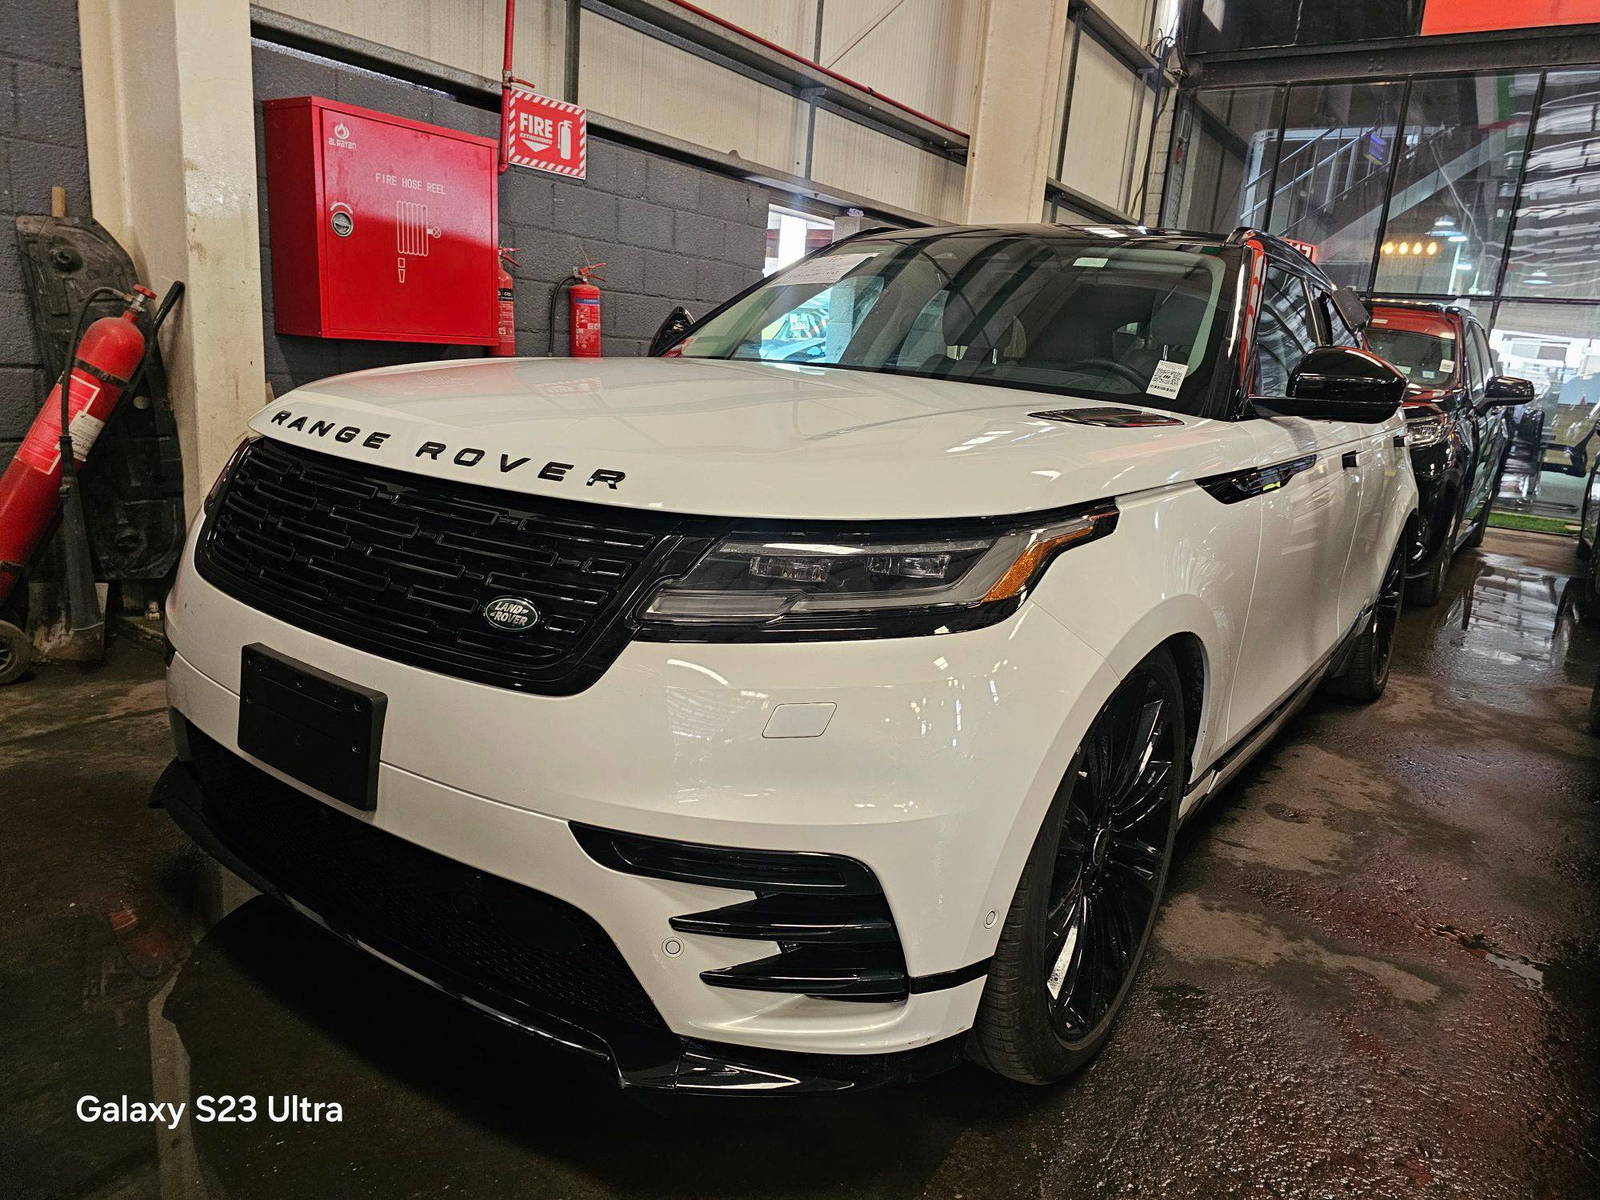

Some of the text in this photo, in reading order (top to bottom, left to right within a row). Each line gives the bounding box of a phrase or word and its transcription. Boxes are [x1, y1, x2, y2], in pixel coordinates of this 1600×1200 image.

[520, 112, 553, 138] FIRE
[375, 172, 447, 195] FIRE HOSE REEL
[271, 409, 626, 490] RANGE ROVER
[493, 611, 529, 626] ROVER
[494, 601, 523, 614] LAND
